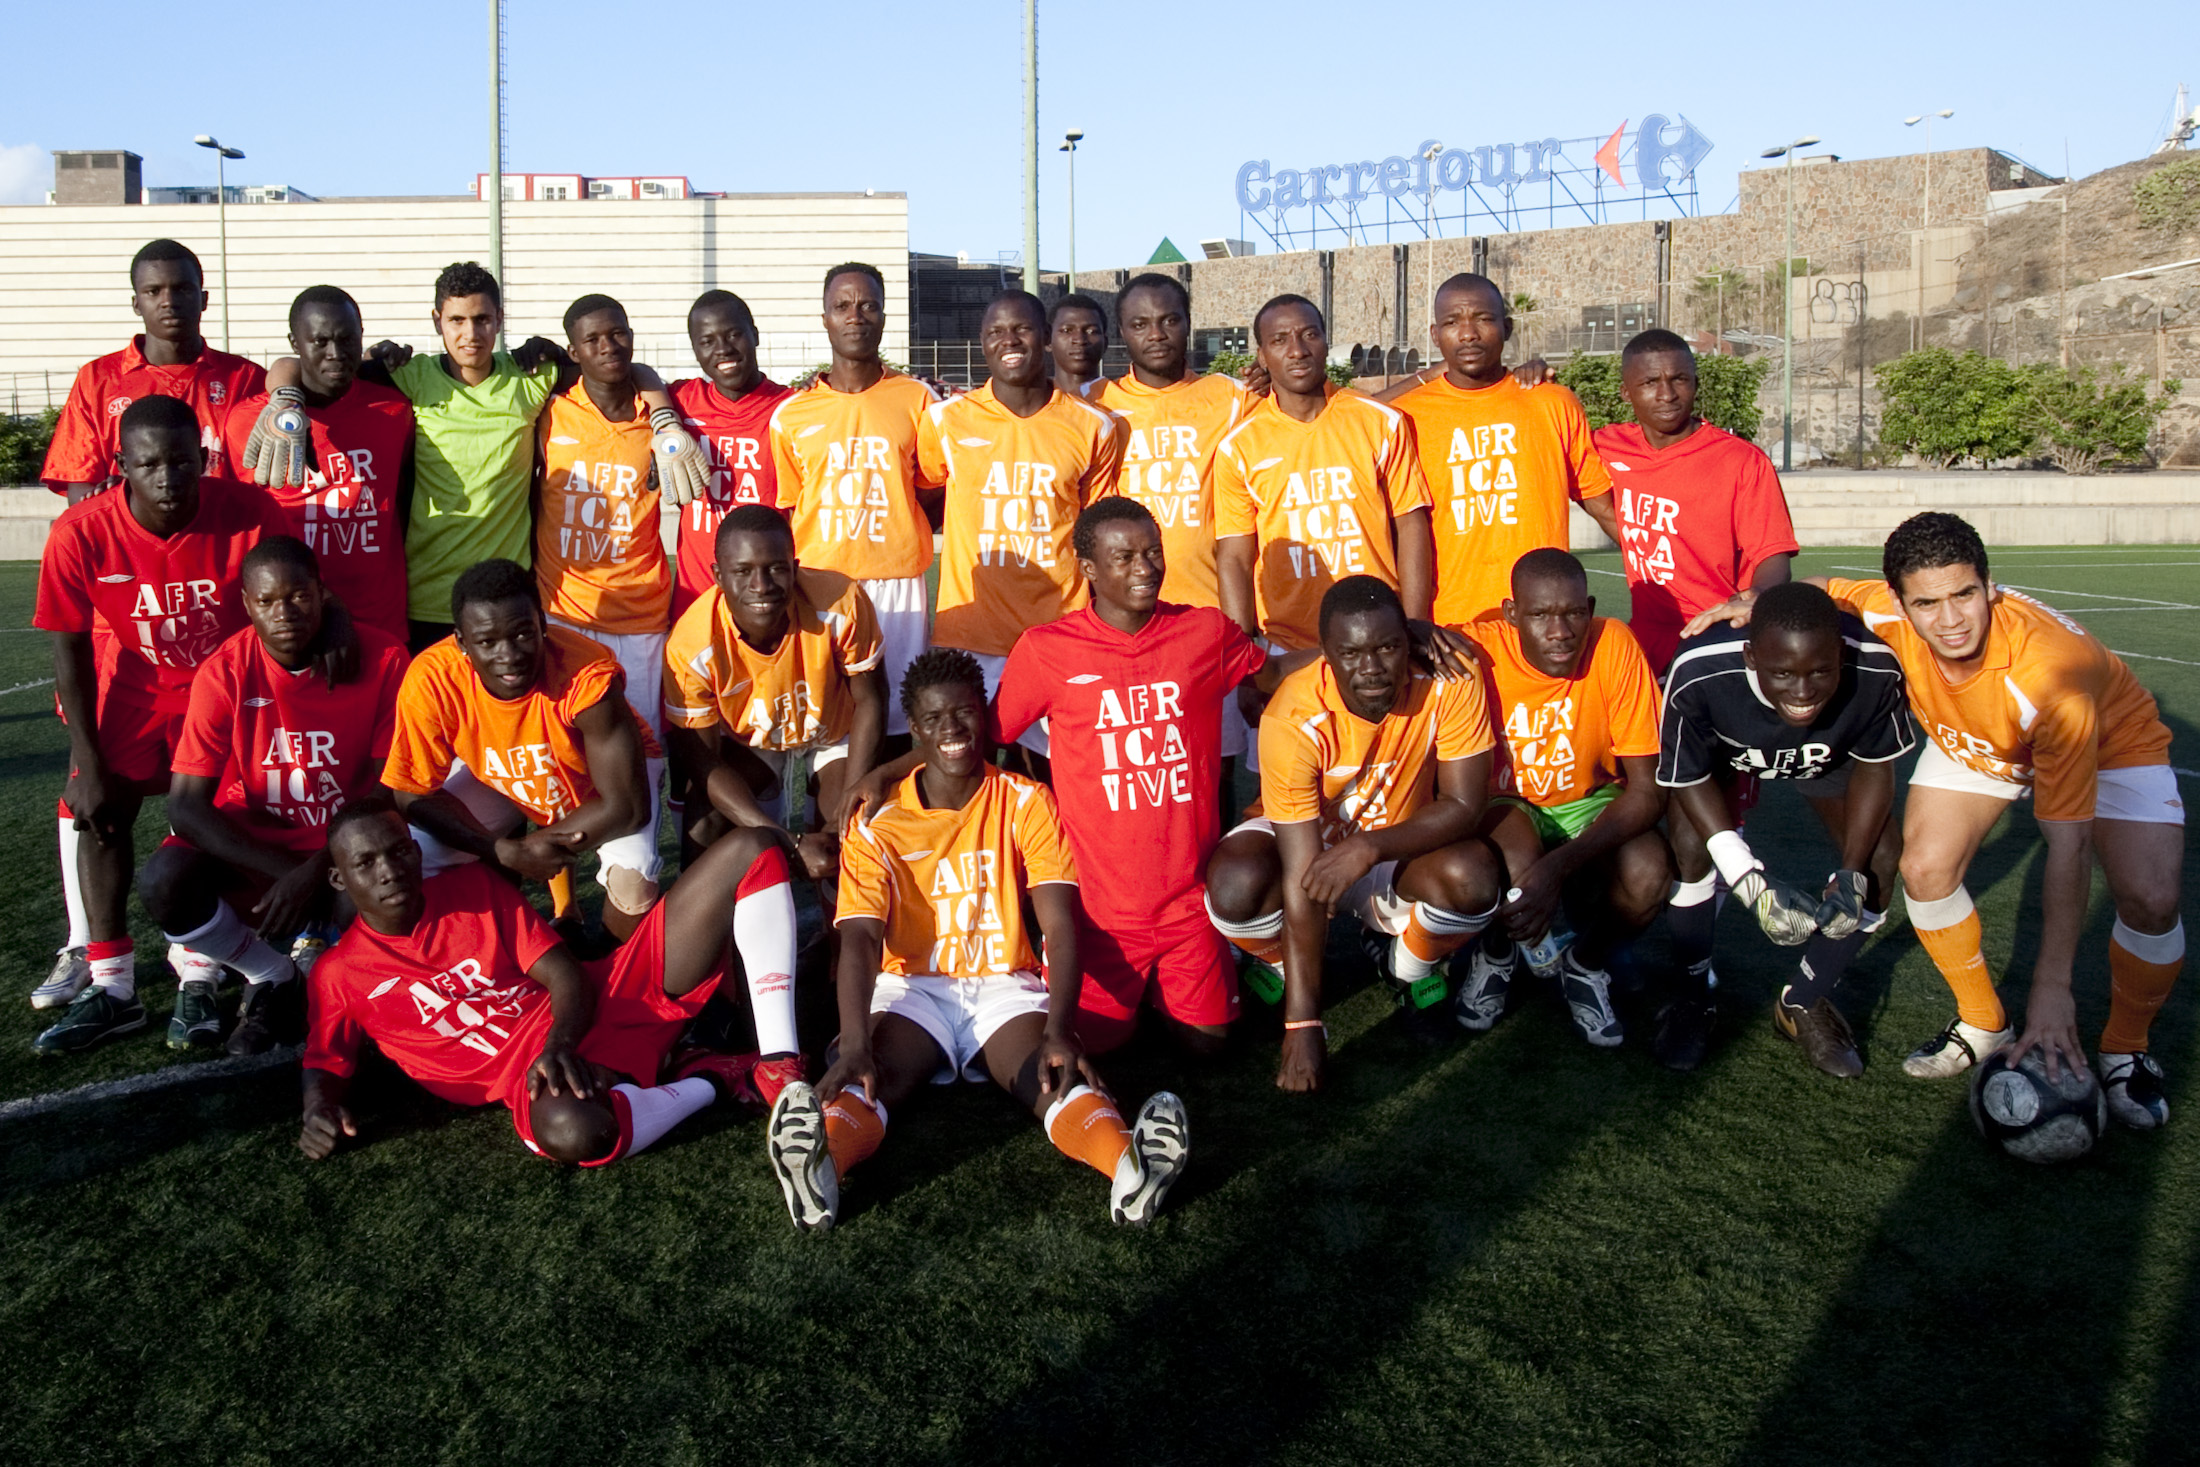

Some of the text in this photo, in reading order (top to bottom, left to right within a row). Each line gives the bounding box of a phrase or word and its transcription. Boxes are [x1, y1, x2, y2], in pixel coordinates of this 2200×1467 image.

[1236, 138, 1561, 212] Carrefour
[825, 435, 891, 477] AFR
[1124, 425, 1201, 462] AFR
[1447, 423, 1518, 464] AFR
[563, 460, 638, 498] AFR
[709, 470, 761, 503] CA
[819, 472, 889, 507] ICA
[980, 461, 1056, 498] AFR
[1124, 461, 1201, 494] ICA
[1282, 466, 1357, 508] AFR
[1447, 458, 1518, 497] ICA
[304, 485, 378, 521] ICA
[563, 493, 634, 532] ICA
[979, 497, 1052, 532] ICA
[1283, 503, 1362, 541] ICA
[1620, 487, 1680, 535] AFR
[130, 578, 220, 617] AFR
[131, 610, 220, 648] ICA
[1094, 681, 1184, 730] AFR
[1503, 696, 1574, 738] AFR
[261, 727, 340, 768] AFR
[484, 743, 557, 779] AFR
[1095, 723, 1188, 771] ICA
[1731, 743, 1832, 770] AFR
[261, 767, 343, 805] ICA
[1101, 762, 1192, 812] ViVE
[930, 849, 996, 897] AFR
[931, 892, 1003, 937] ICA
[408, 958, 496, 1025] AFR
